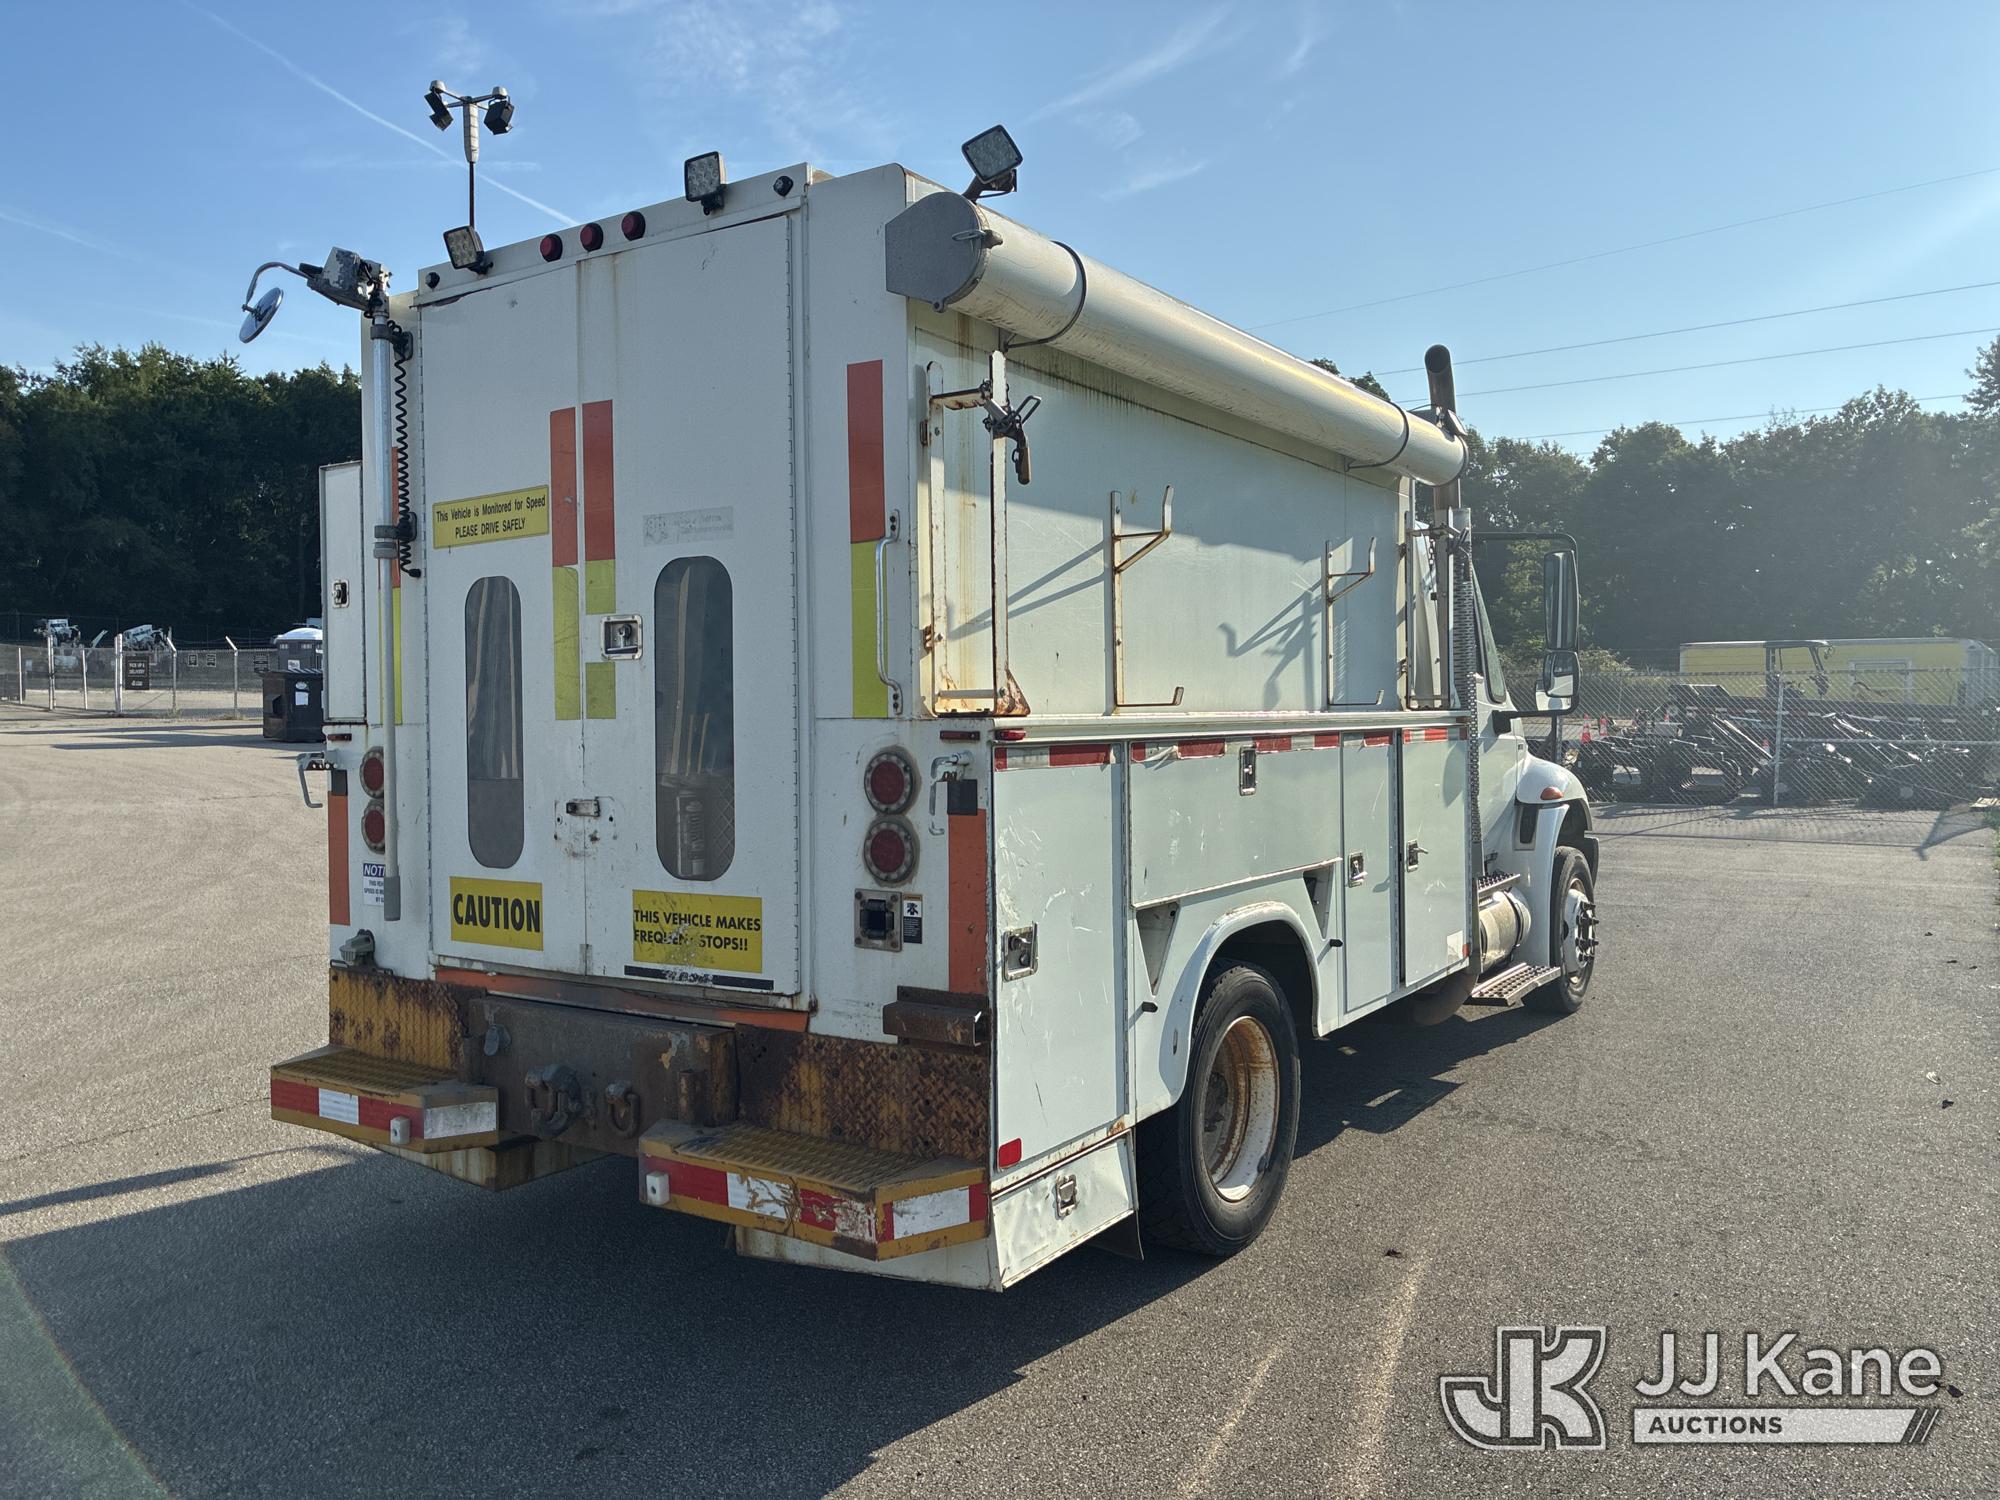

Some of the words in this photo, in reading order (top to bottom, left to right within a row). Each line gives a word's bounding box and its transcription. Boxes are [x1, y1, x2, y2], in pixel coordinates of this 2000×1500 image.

[436, 511, 448, 522] This
[451, 507, 471, 520] Vehicle
[474, 506, 480, 517] is
[482, 500, 512, 515] Monitored
[515, 499, 523, 511] for
[526, 495, 546, 511] Speed
[455, 525, 478, 538] PLEASE
[481, 521, 499, 535] DRIVE
[503, 518, 526, 532] SAFELY
[364, 864, 385, 876] NOTI
[453, 893, 540, 933] CAUTION
[634, 910, 660, 924] THIS
[663, 912, 711, 928] VEHICLE
[716, 916, 761, 932] MAKES
[699, 935, 748, 951] STOPS!!
